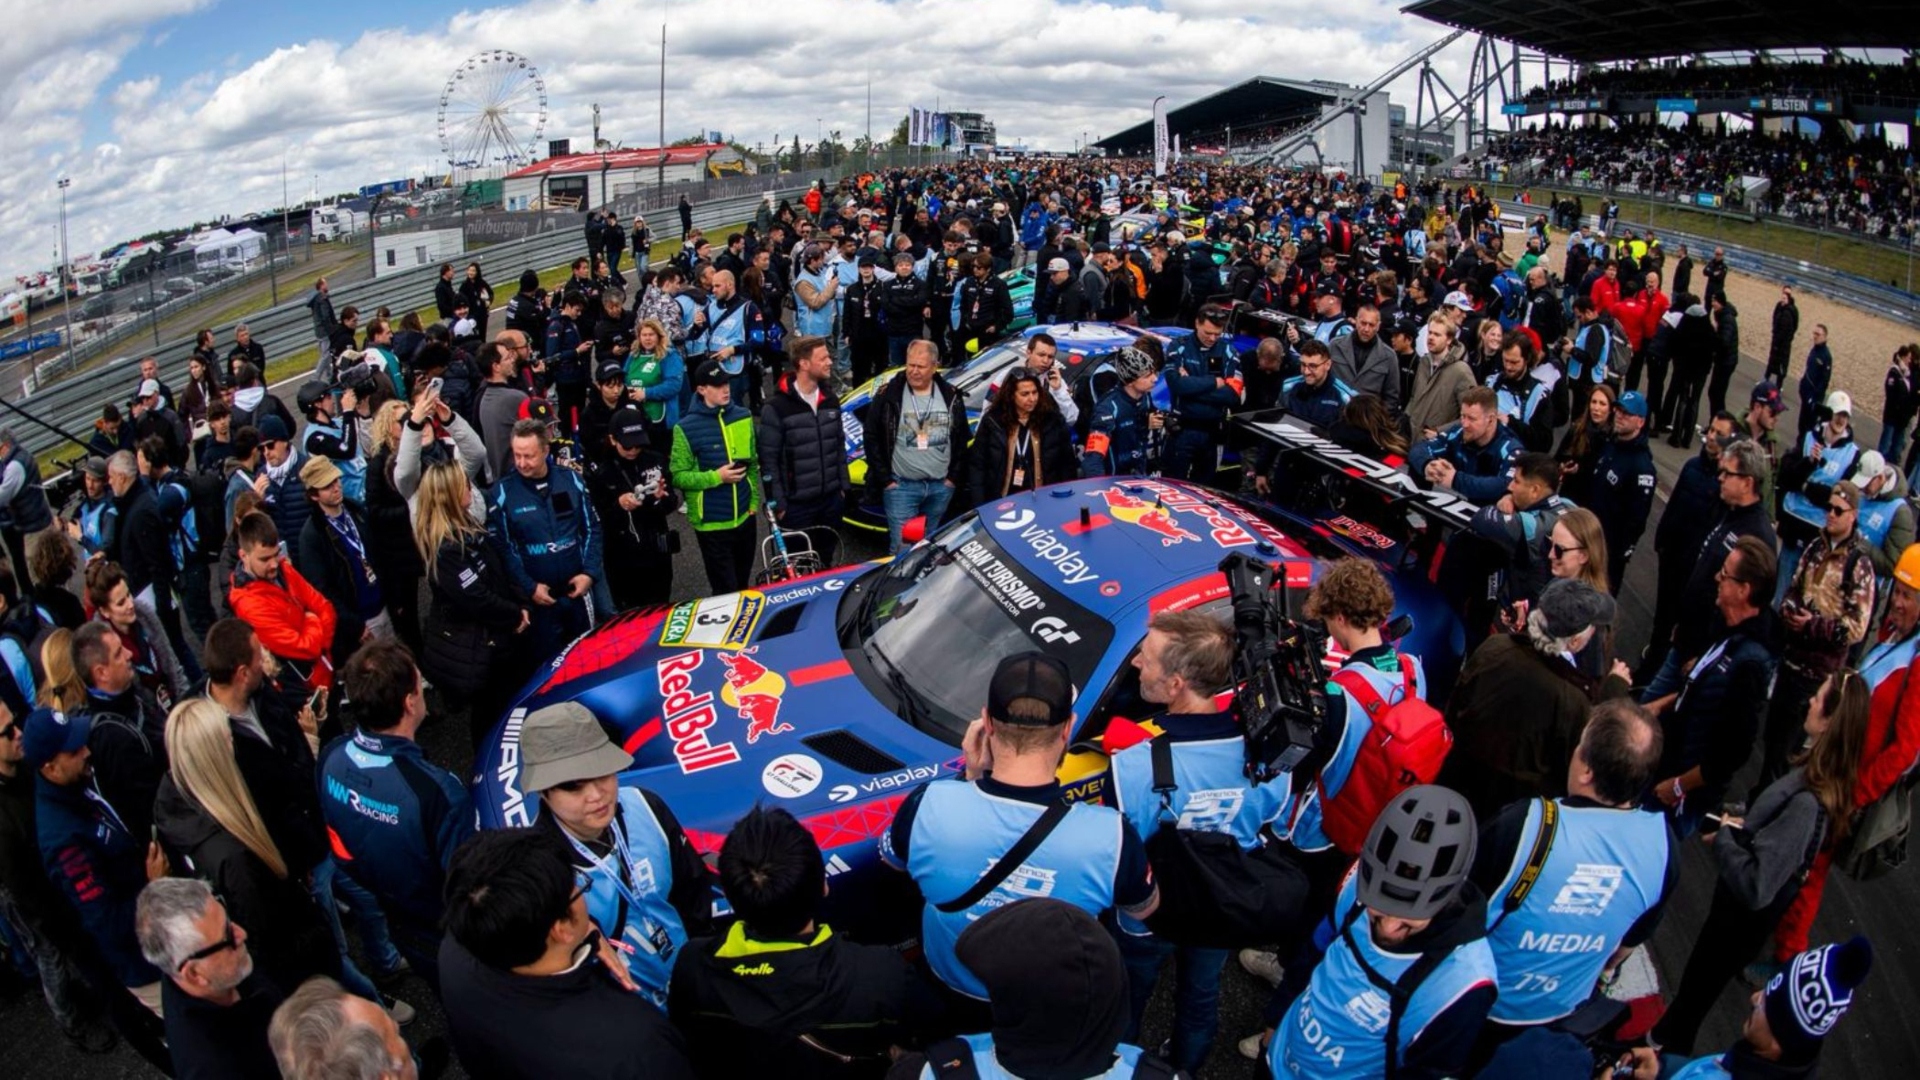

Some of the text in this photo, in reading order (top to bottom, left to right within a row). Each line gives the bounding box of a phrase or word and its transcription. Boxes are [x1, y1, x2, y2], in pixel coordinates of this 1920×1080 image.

[1563, 101, 1586, 110] BILSTEIN
[1772, 99, 1808, 111] BILSTEIN
[466, 219, 528, 237] nürburgring
[960, 540, 995, 567] GRAN
[1020, 524, 1099, 584] viaplay
[765, 585, 822, 606] viaplay
[987, 585, 1021, 617] SIMULATOR
[697, 614, 731, 625] 3
[860, 763, 940, 793] viaplay
[1518, 930, 1606, 953] MEDIA
